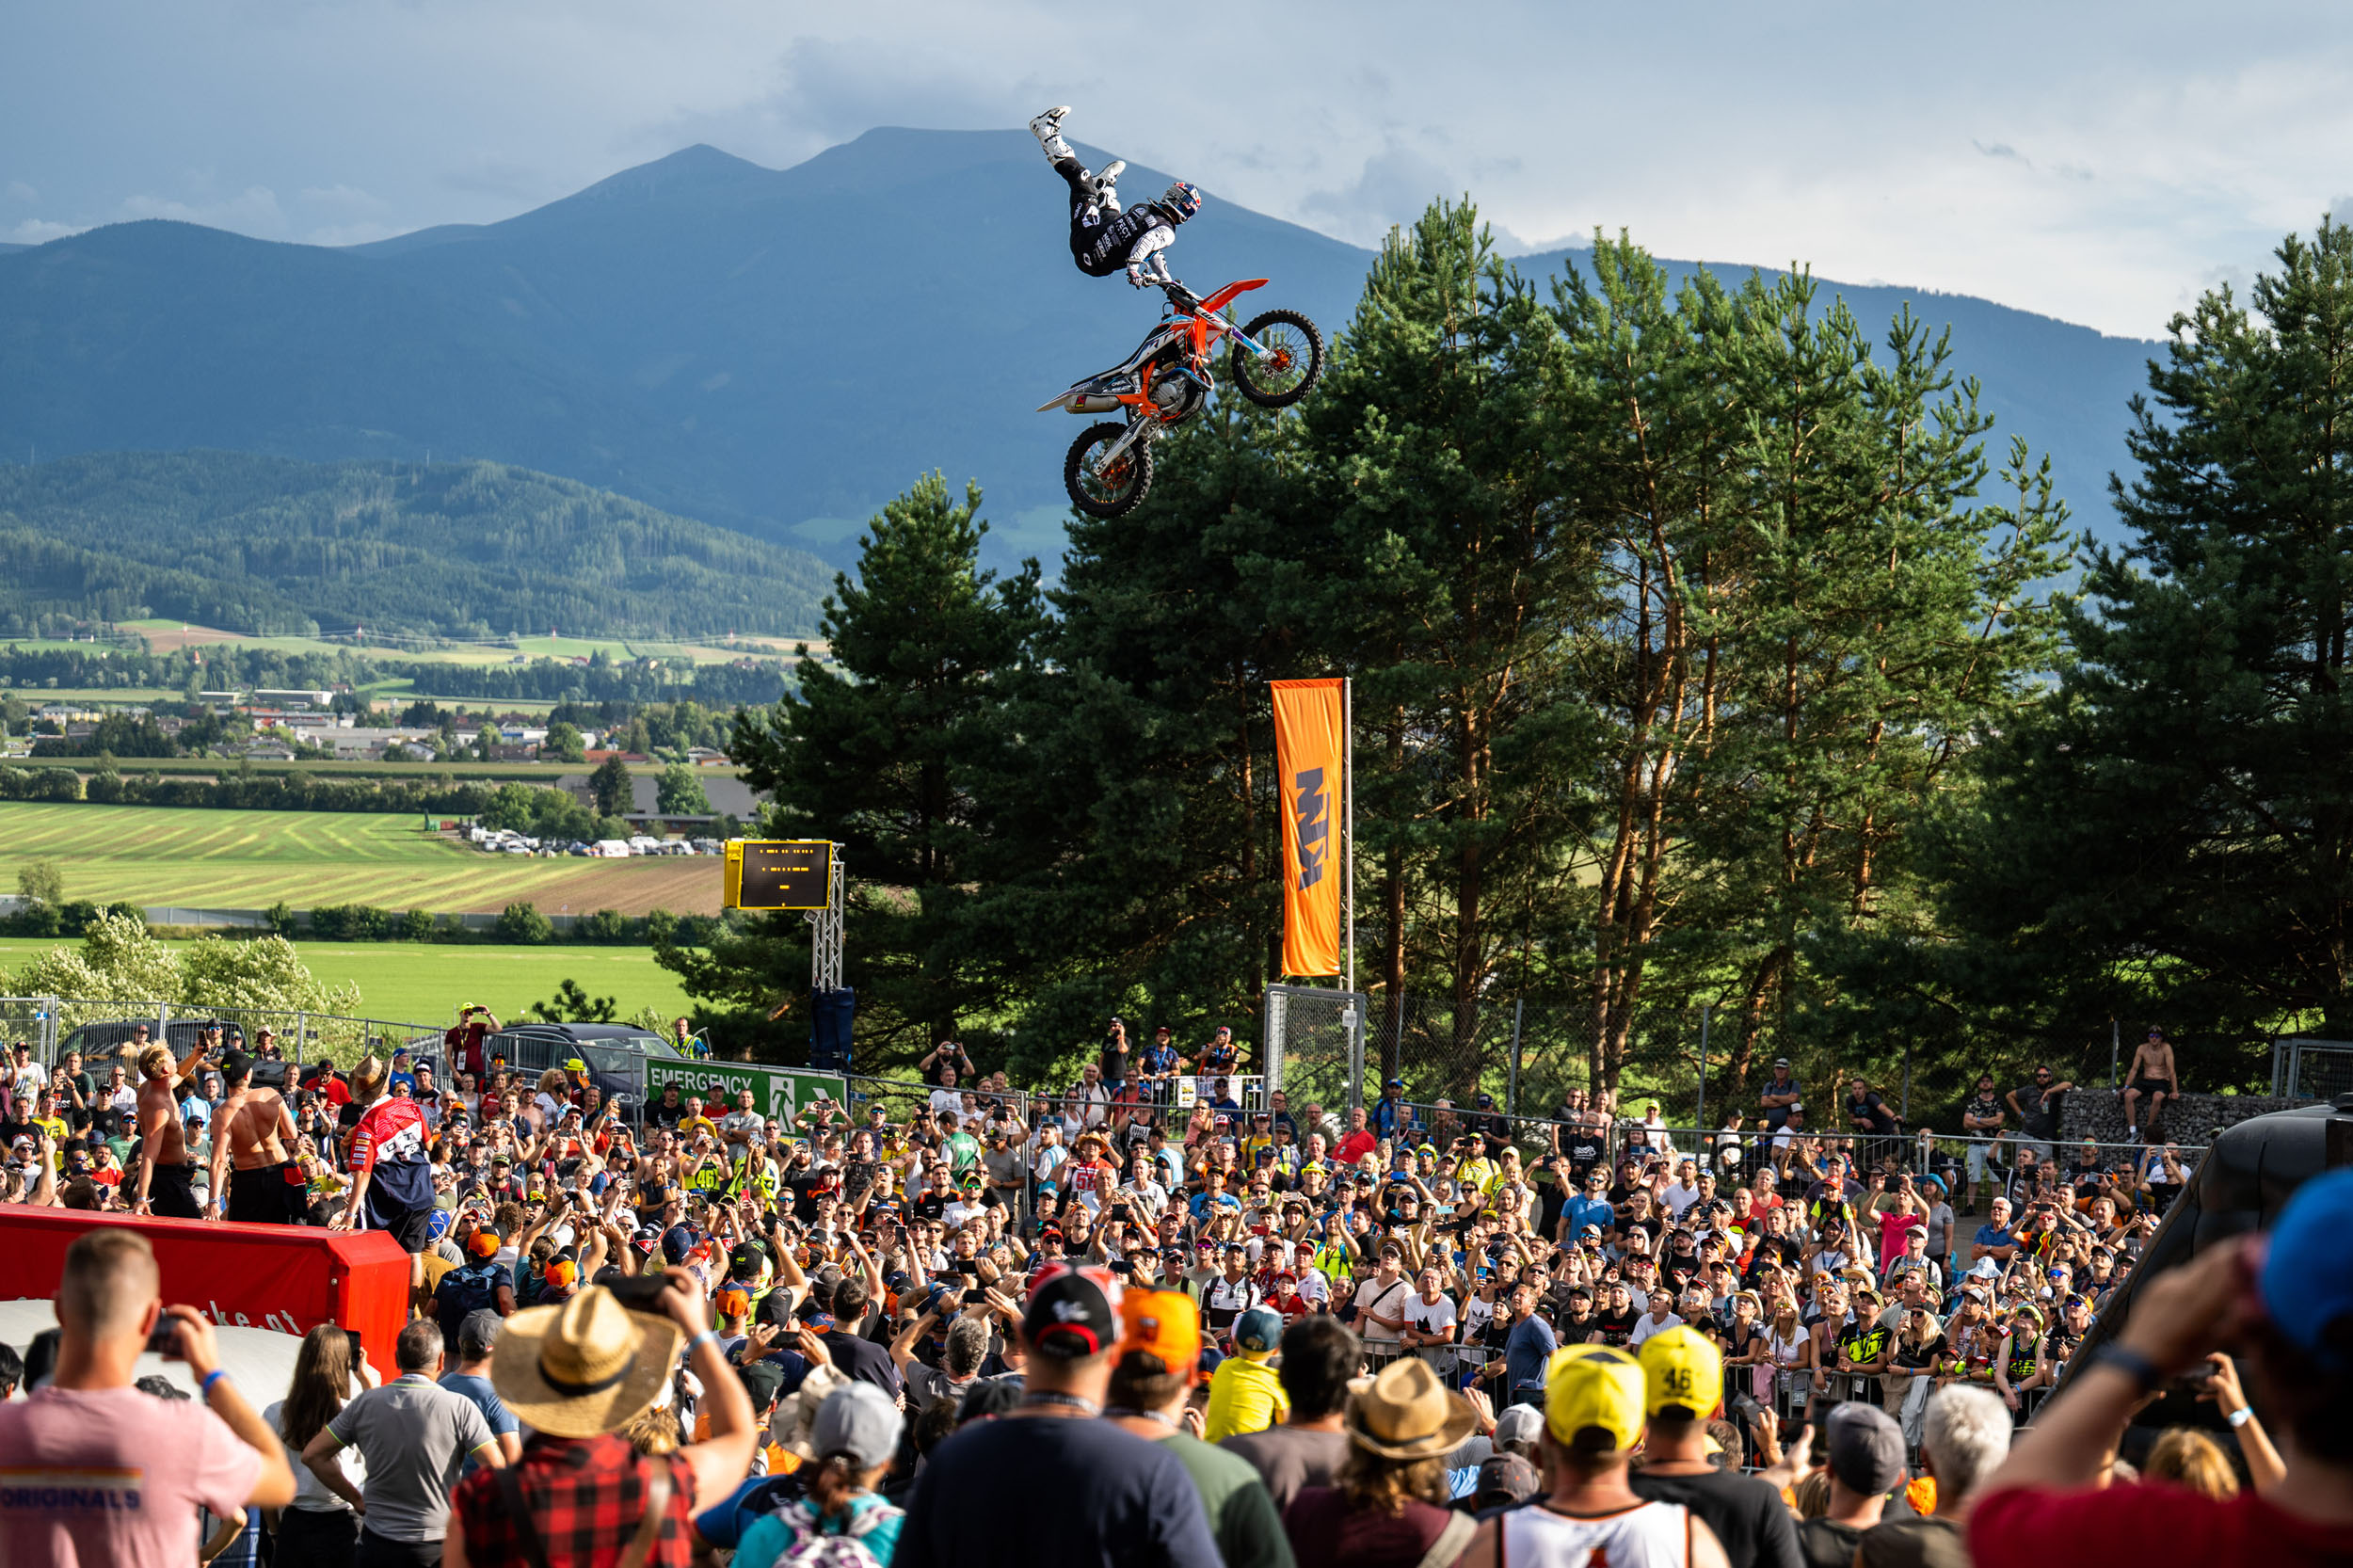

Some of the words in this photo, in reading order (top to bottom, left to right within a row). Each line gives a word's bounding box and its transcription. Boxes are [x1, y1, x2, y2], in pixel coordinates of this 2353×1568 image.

[1143, 329, 1185, 354] KTM
[1295, 767, 1330, 891] KTM
[651, 1068, 752, 1095] EMERGENCY
[696, 1169, 715, 1189] 46
[1663, 1368, 1691, 1390] 46
[1, 1487, 141, 1510] ORIGINALS
